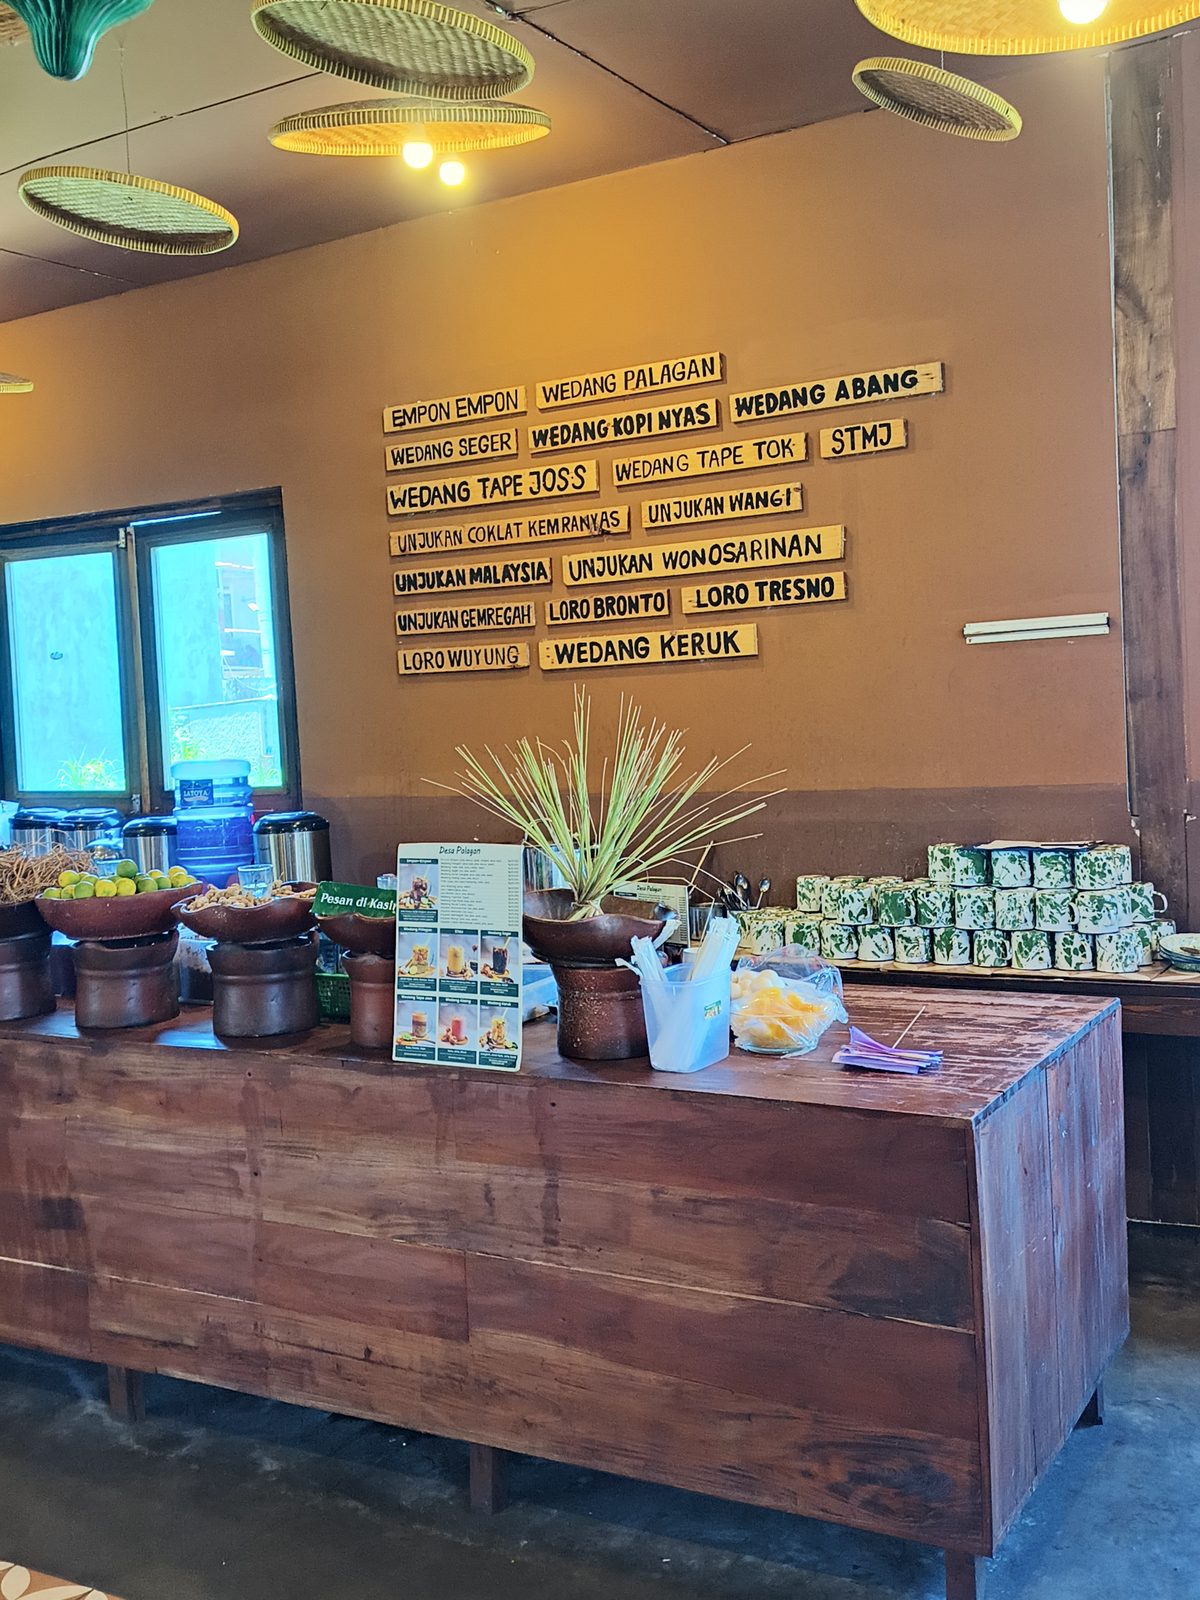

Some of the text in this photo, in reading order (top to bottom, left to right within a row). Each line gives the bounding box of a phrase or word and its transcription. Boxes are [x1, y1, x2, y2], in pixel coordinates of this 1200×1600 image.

[542, 357, 715, 402] WEDANG PALAGAN
[736, 370, 918, 416] WEDANG ABANG
[393, 390, 518, 427] EMPON EMPON
[533, 404, 710, 447] WEDANG KOPI NYAS
[391, 433, 511, 465] WEDANG SEGER
[832, 423, 892, 454] STMJ
[616, 438, 794, 481] WEDANG TAPE TOK
[390, 465, 586, 509] WEDANG TAPE JOSS
[648, 488, 791, 523] UNJUKAN WANGI
[398, 511, 620, 552] UNJUKAN COKLAT KEMRANYAS
[569, 534, 822, 581] UNJUKAN WONOSARINAN
[396, 561, 548, 592] UNJUKAN MALAYSIA
[696, 577, 834, 607] LORO TRESNO
[398, 605, 531, 631] UNJUKAN GEMREGAH
[549, 592, 665, 621] LORO BRONTO
[403, 646, 518, 670] LORO WUYUNG
[555, 630, 740, 664] WEDANG KERUK
[439, 846, 454, 854] Desa
[321, 893, 353, 905] Pesan
[356, 897, 367, 907] di
